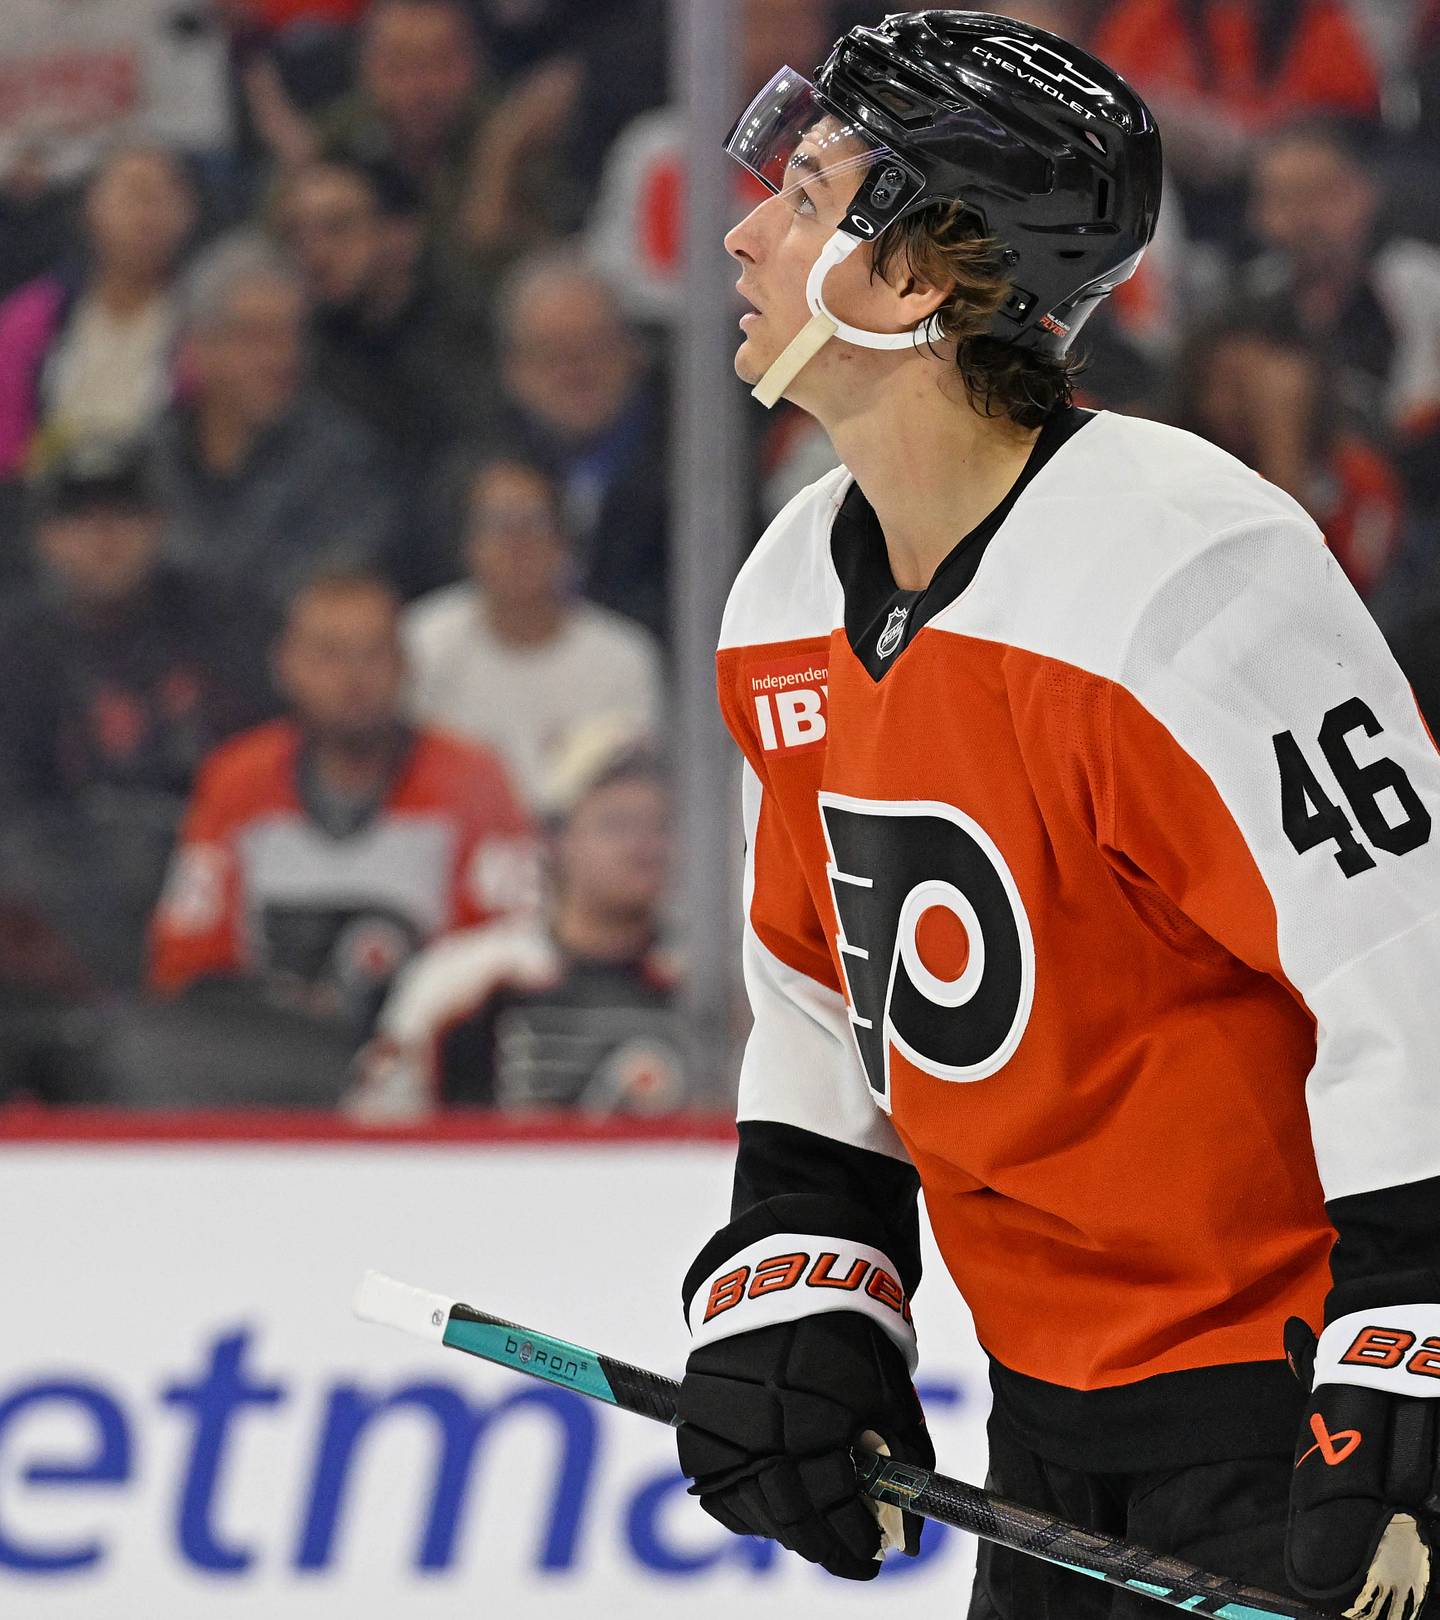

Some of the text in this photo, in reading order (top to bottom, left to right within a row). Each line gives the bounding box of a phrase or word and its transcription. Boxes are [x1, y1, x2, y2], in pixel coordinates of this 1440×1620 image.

[971, 46, 1097, 120] CHEVROLET
[752, 667, 829, 691] Independen
[754, 685, 829, 751] IB
[1272, 696, 1432, 879] 46
[703, 1251, 911, 1325] Baue
